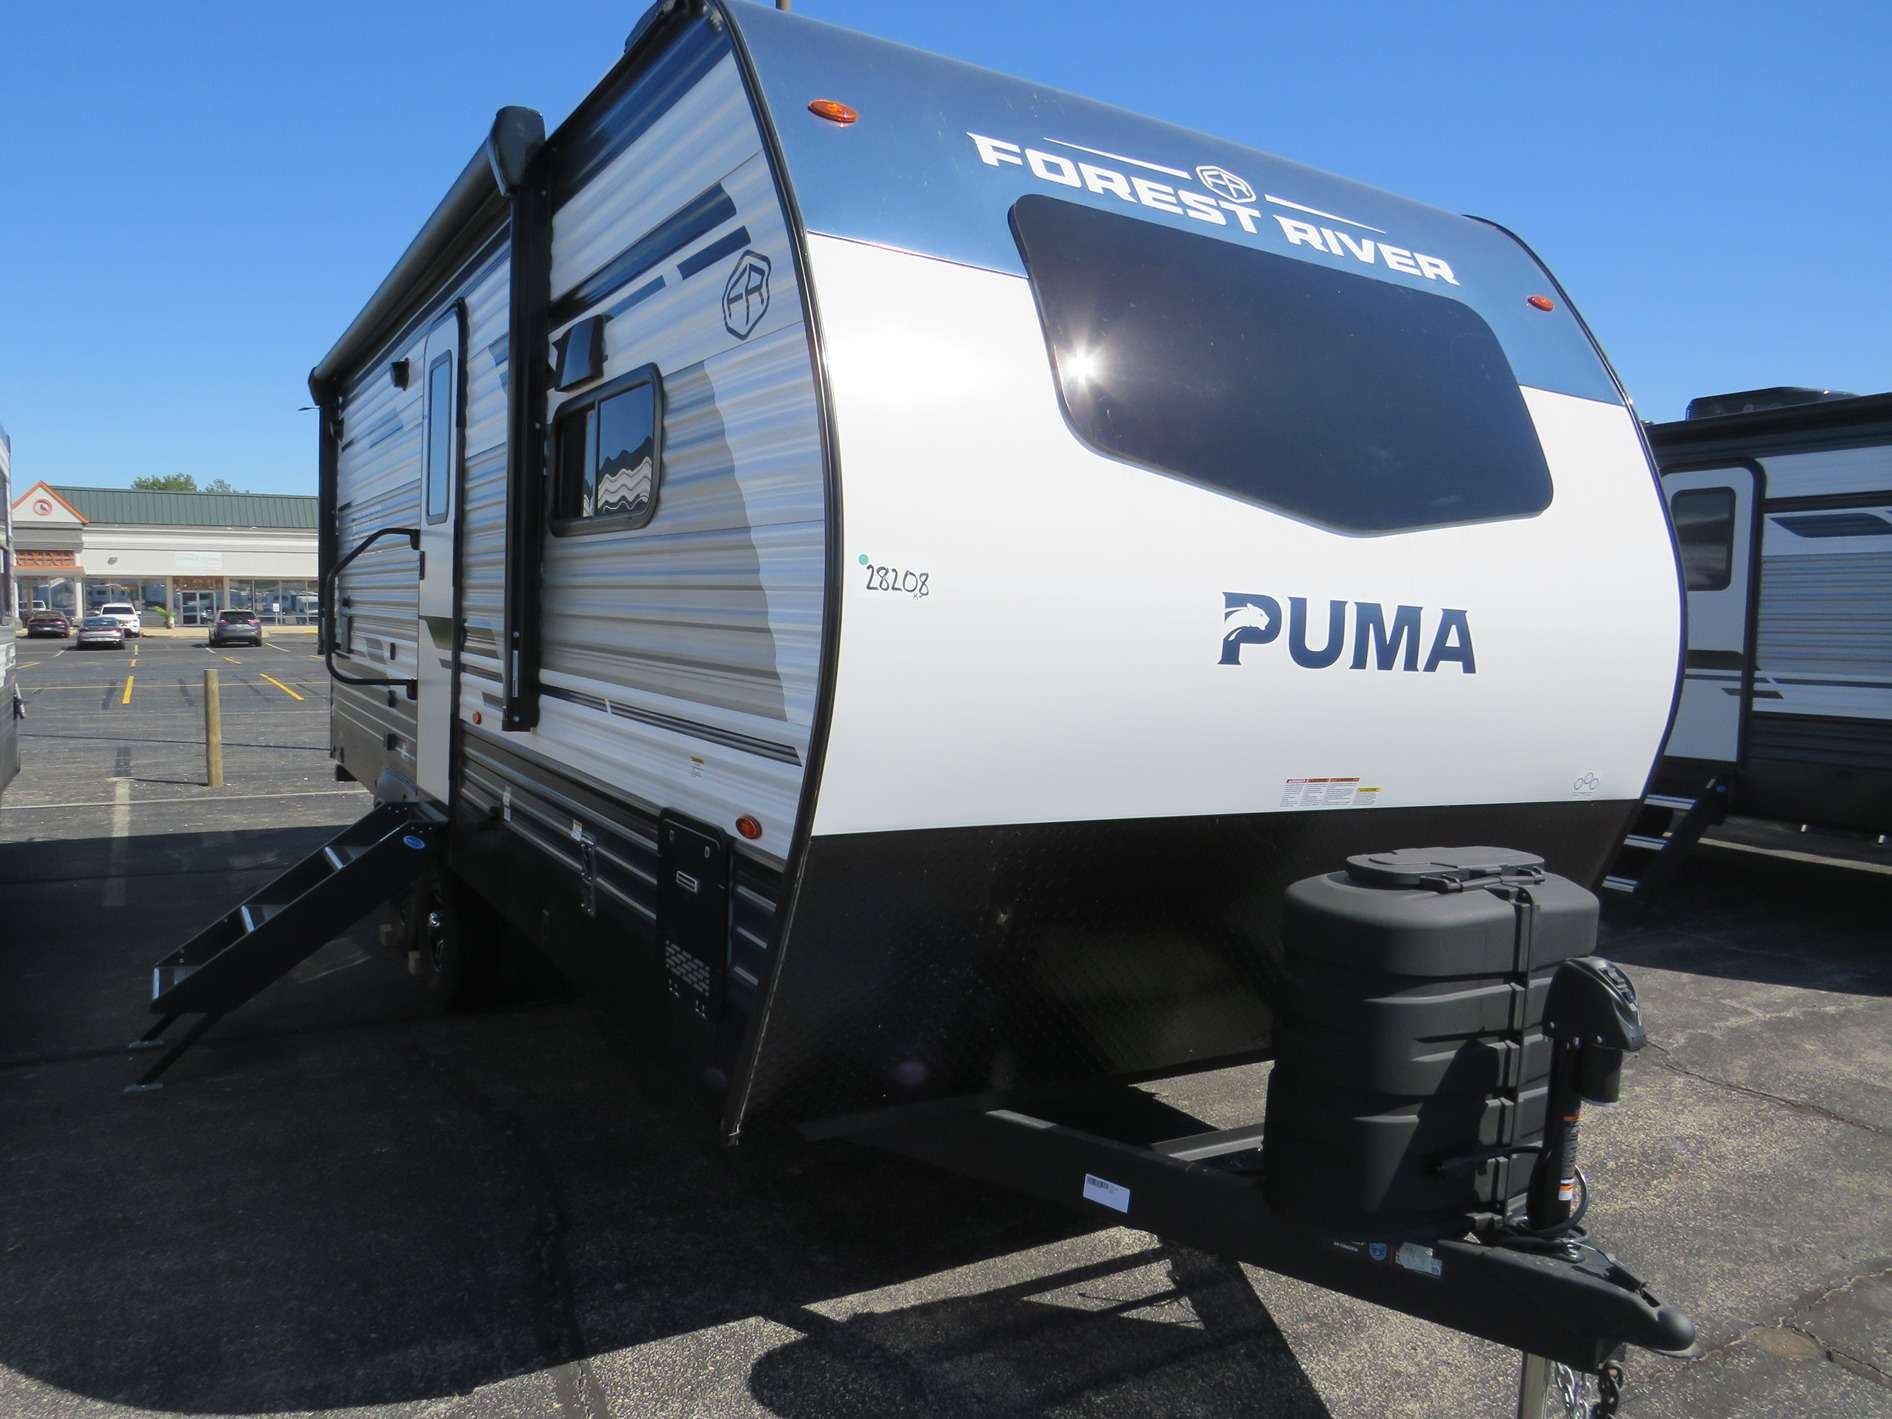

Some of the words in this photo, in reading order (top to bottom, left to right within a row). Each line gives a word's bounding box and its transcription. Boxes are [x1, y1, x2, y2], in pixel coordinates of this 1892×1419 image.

[966, 131, 1261, 234] FOREST
[1273, 214, 1460, 286] RIVER
[866, 564, 929, 596] 28208
[1217, 591, 1477, 674] PUMA
